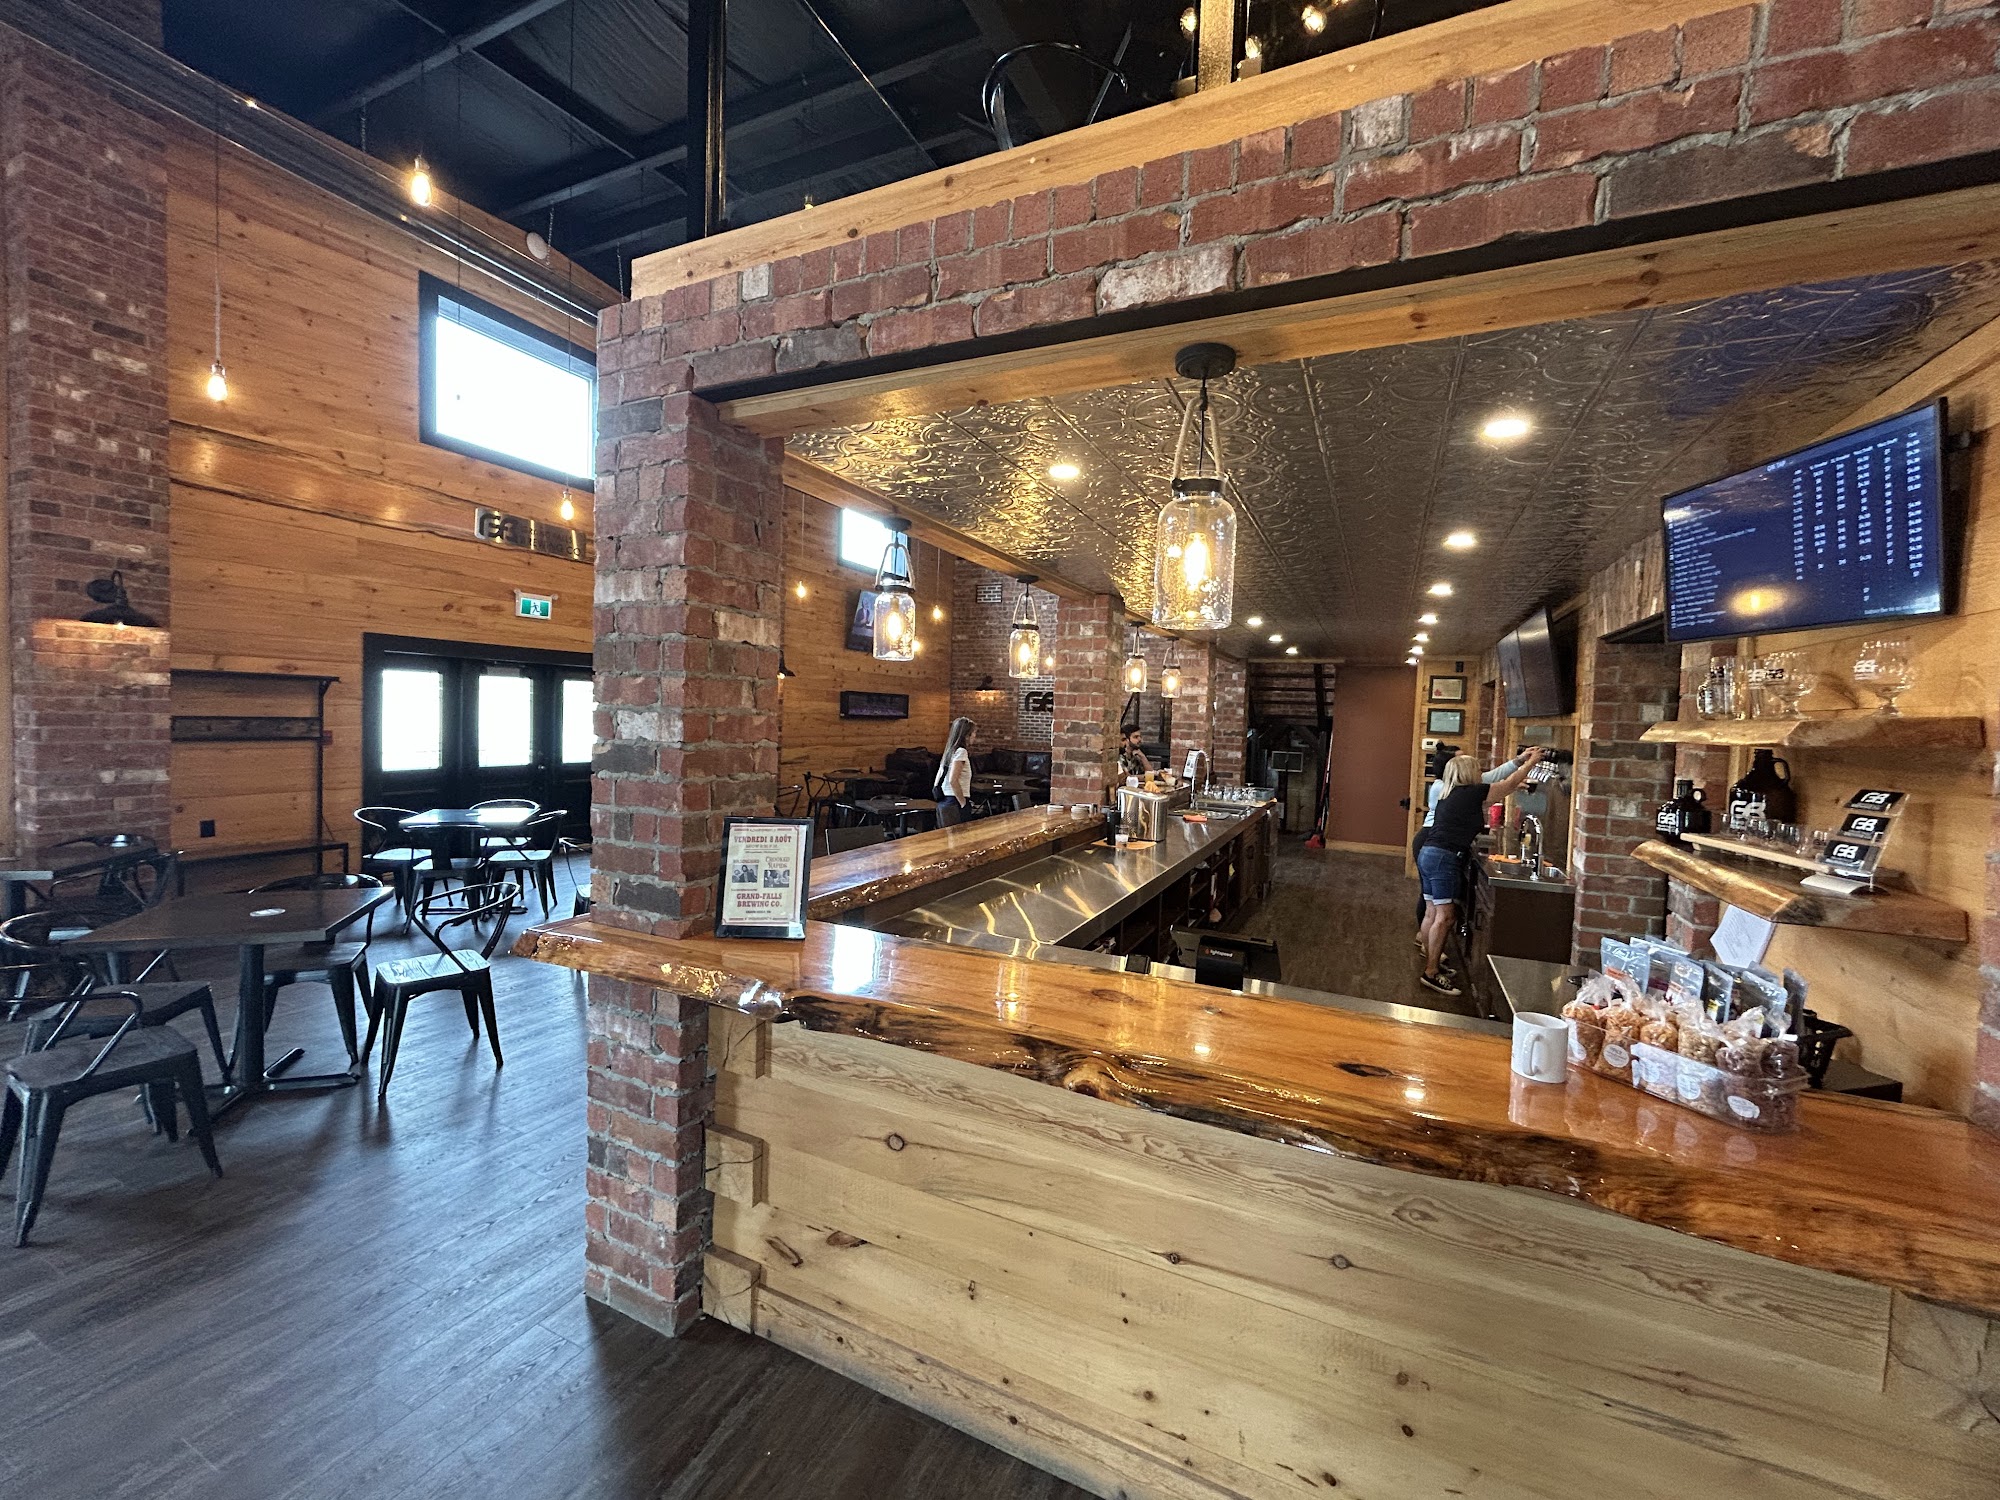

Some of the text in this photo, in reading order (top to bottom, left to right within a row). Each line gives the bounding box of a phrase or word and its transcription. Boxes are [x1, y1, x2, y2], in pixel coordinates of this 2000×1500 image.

[775, 834, 792, 843] AOÛT
[736, 892, 782, 900] GRAND-FALLS
[737, 900, 782, 908] BREWING CO.
